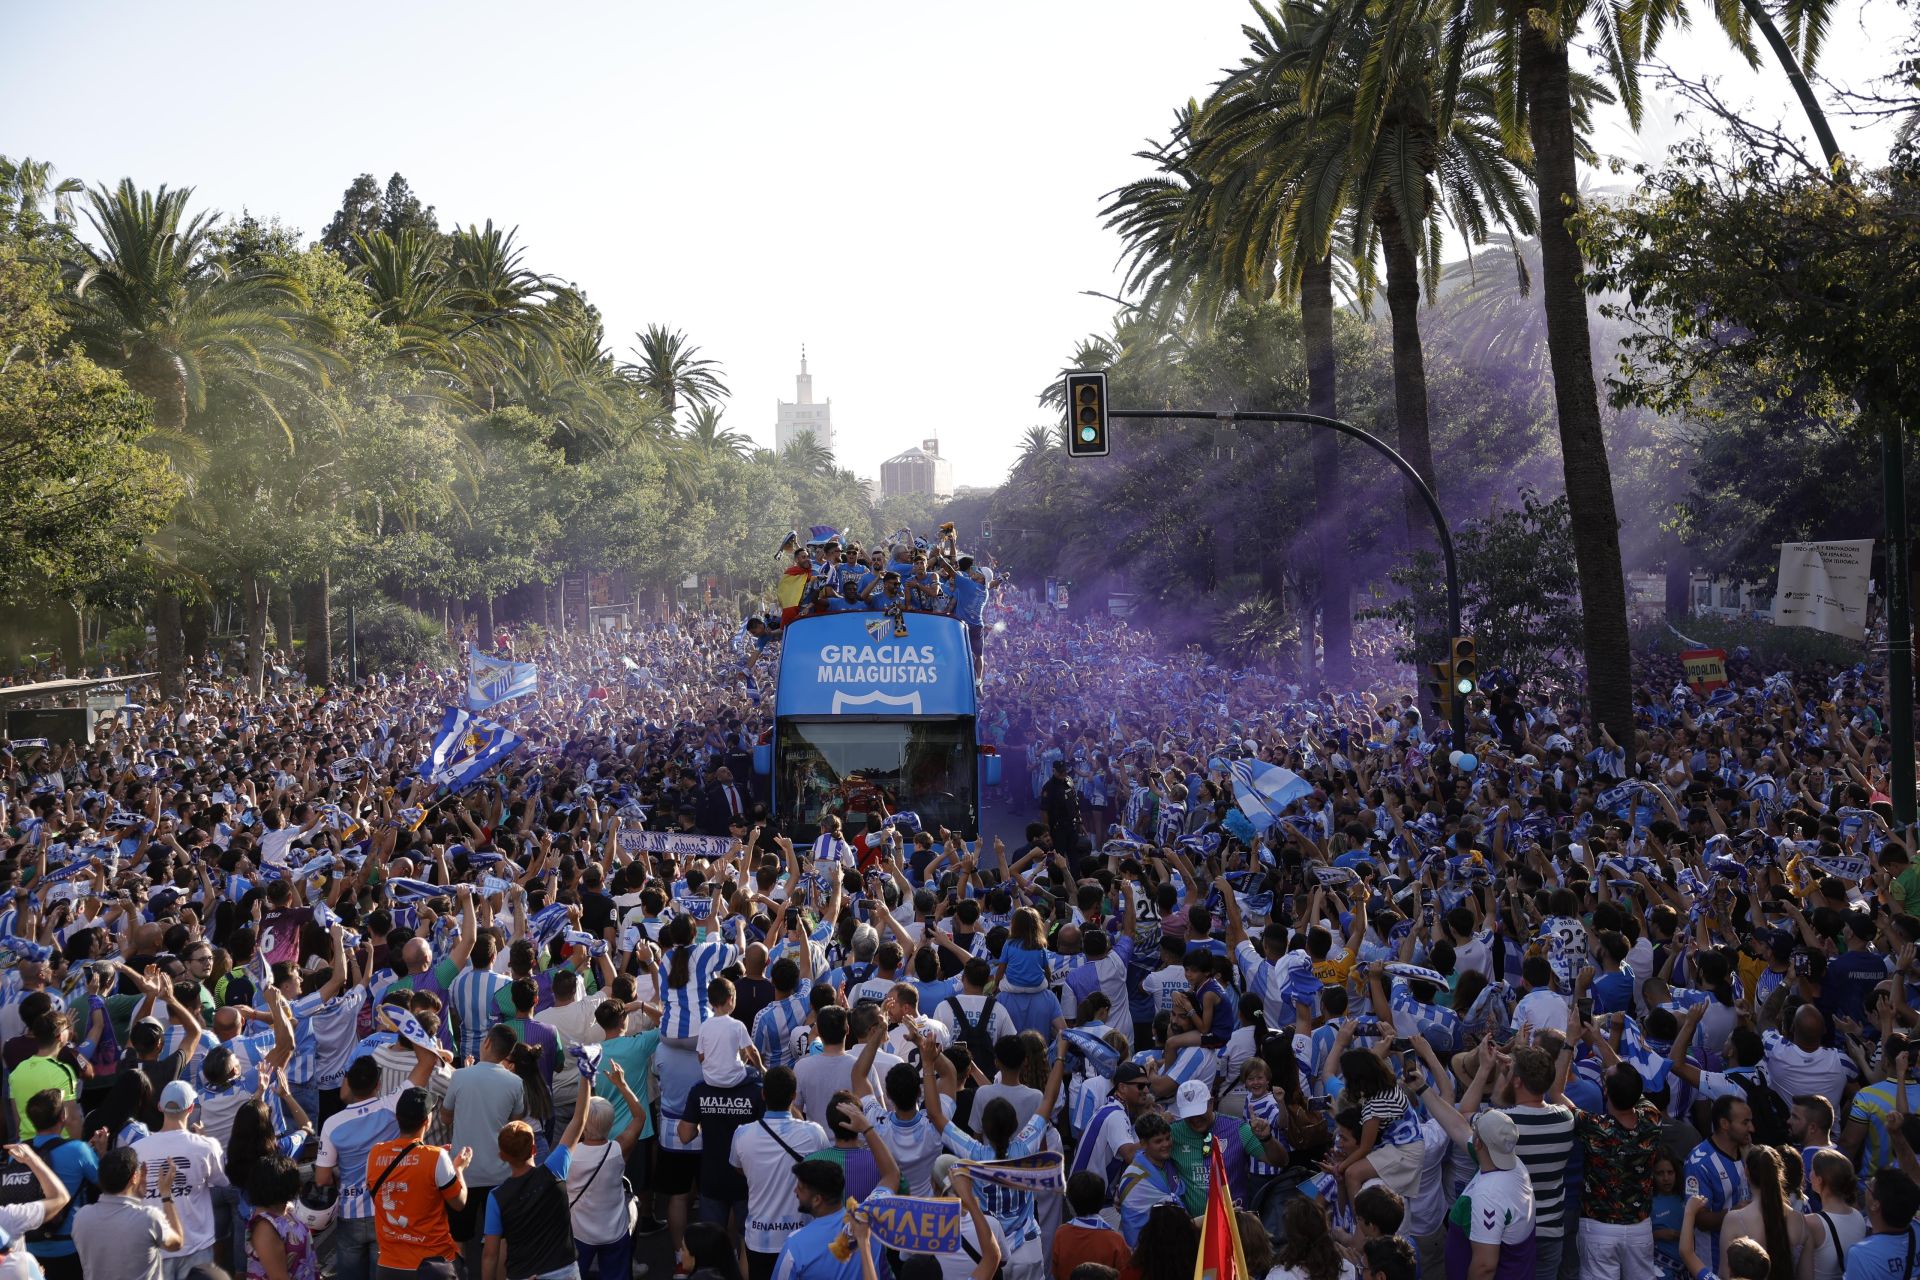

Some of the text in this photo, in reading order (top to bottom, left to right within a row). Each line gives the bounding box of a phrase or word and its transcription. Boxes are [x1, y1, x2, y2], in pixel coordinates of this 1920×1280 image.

[820, 645, 935, 664] GRACIAS
[817, 666, 938, 684] MALAGUISTAS
[261, 926, 276, 953] 6
[1559, 929, 1588, 954] 23
[862, 989, 883, 999] VIVO
[699, 1096, 752, 1109] MALAGA
[701, 1107, 717, 1115] CLUB
[376, 1154, 420, 1168] ANTNES
[2, 1171, 33, 1186] VANS
[752, 1221, 804, 1232] BENAHAVIS
